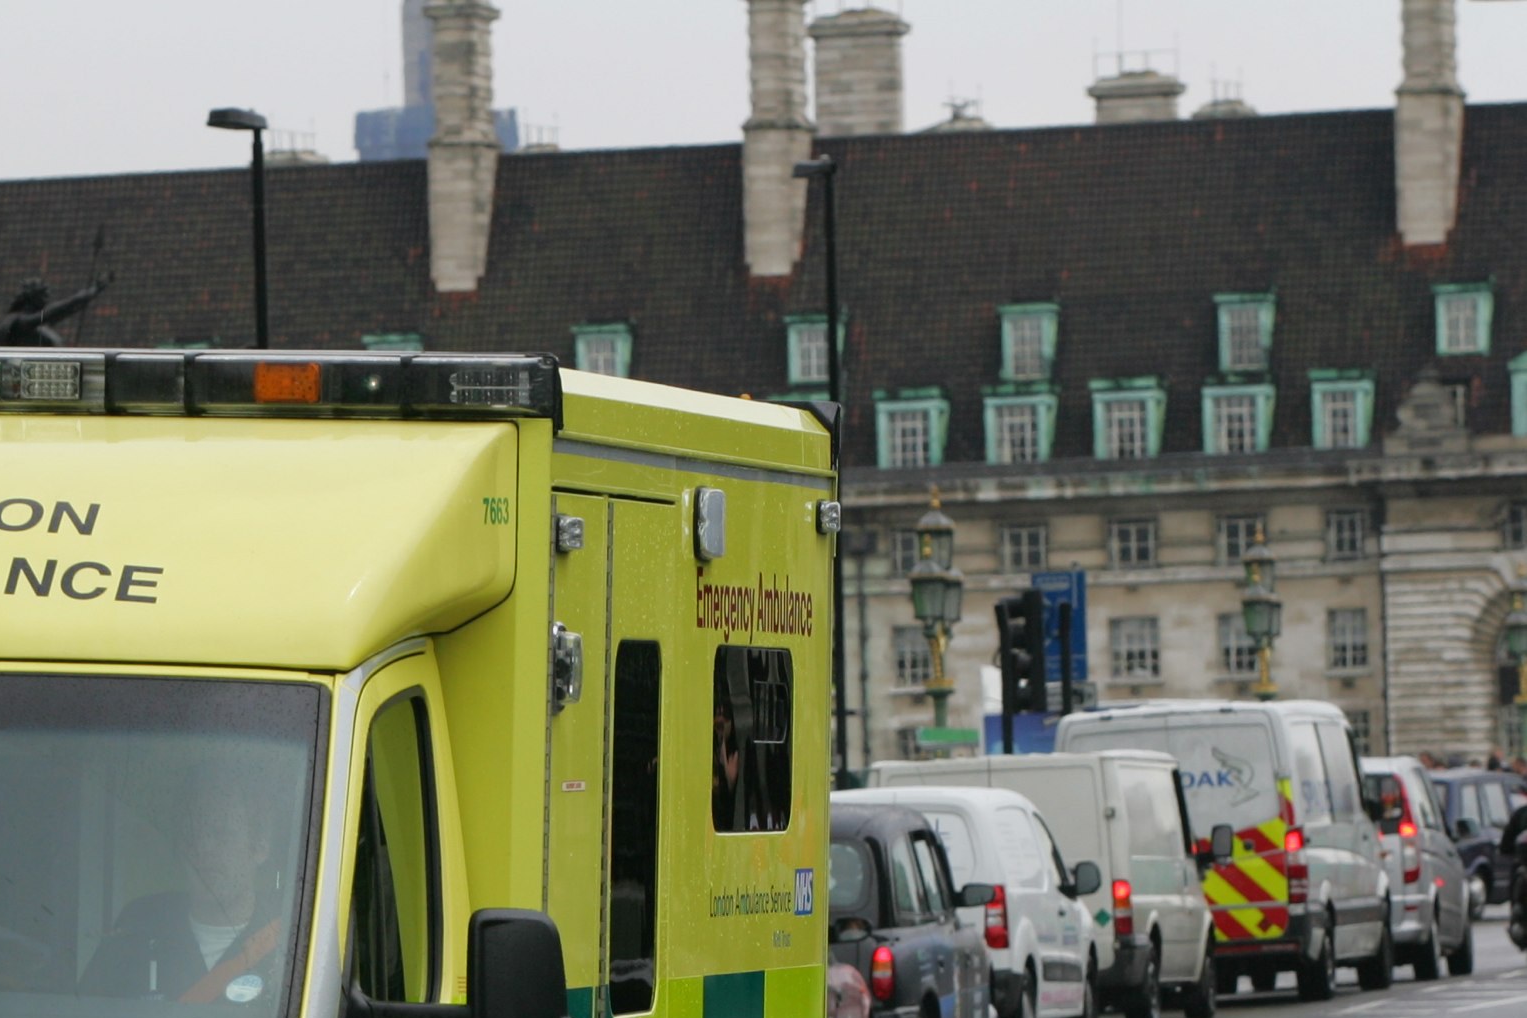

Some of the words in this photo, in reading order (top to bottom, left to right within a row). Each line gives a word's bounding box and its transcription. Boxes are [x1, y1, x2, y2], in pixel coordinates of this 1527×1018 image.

[483, 497, 509, 525] 7663
[696, 566, 755, 645] Emergency
[756, 571, 813, 637] Ambulance
[709, 887, 734, 918] London
[734, 884, 770, 915] Ambulance
[770, 884, 791, 913] Service
[795, 871, 813, 913] NHS
